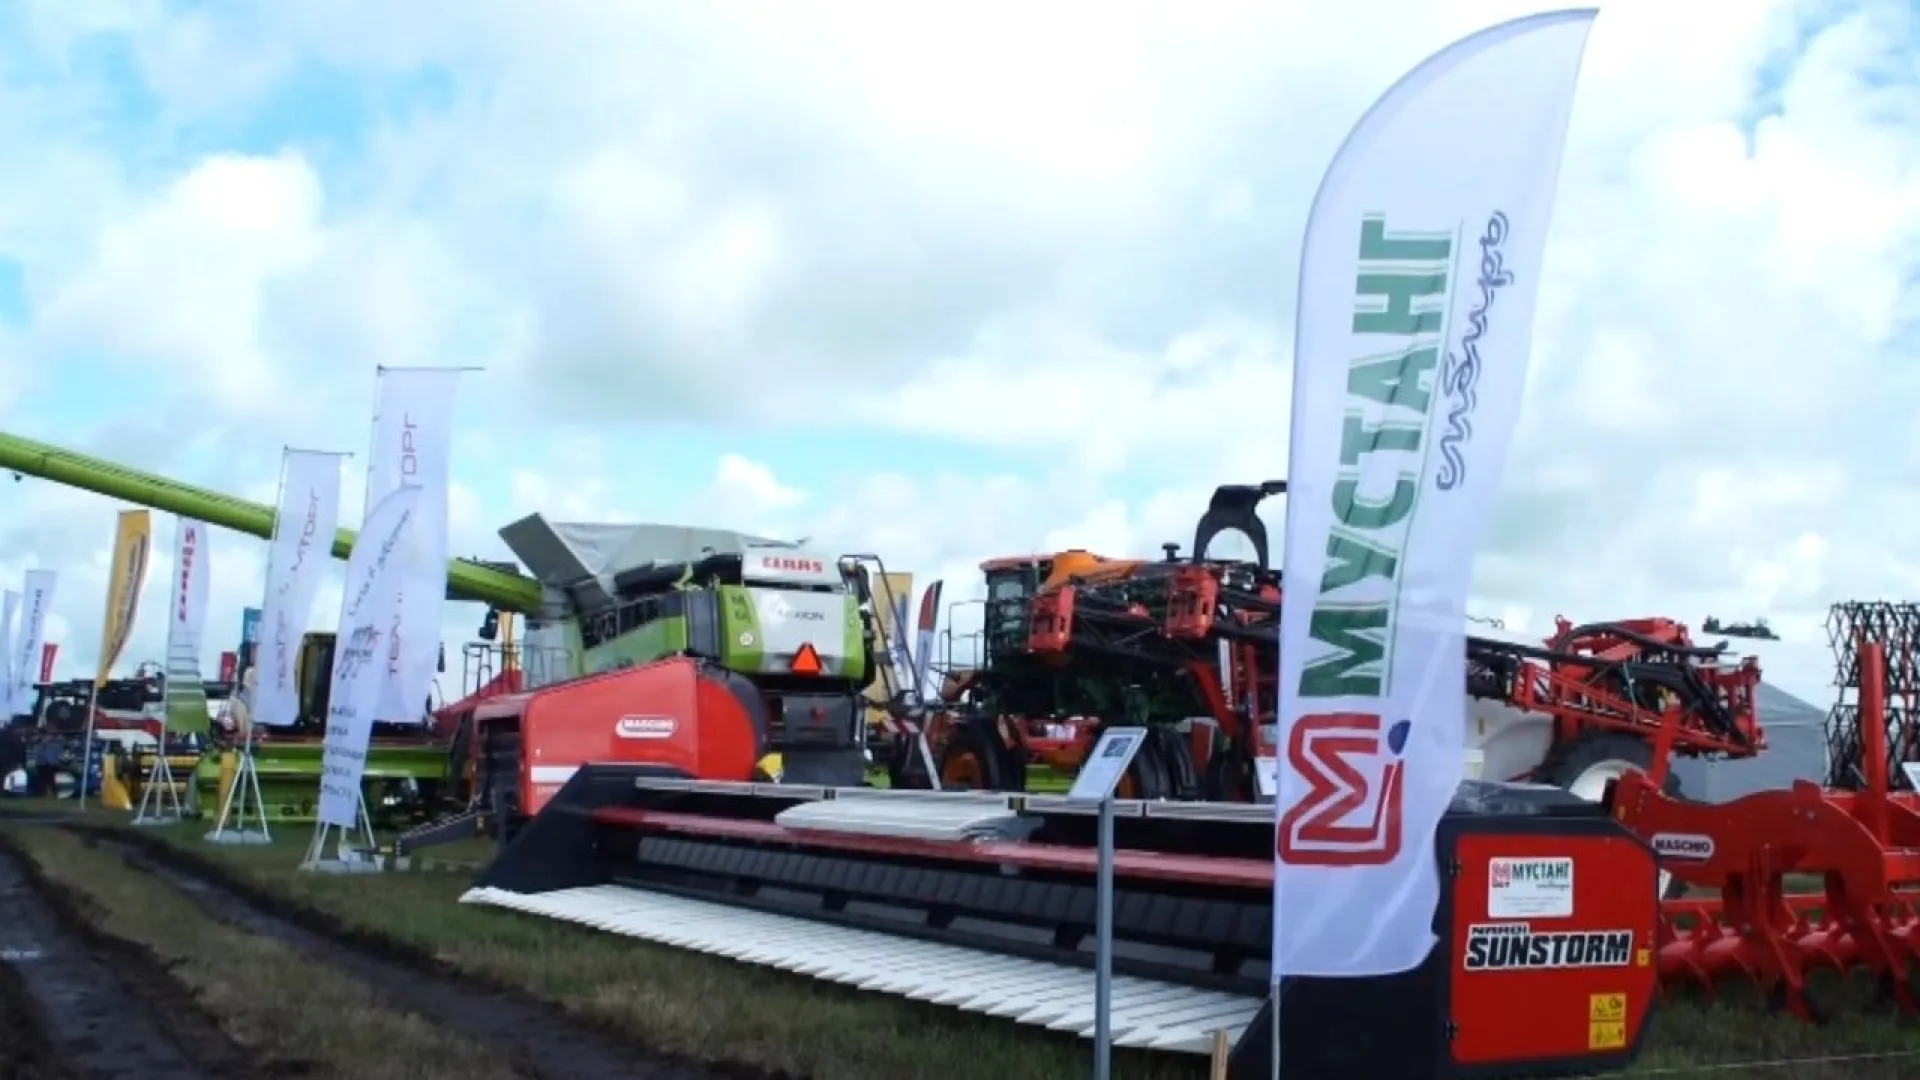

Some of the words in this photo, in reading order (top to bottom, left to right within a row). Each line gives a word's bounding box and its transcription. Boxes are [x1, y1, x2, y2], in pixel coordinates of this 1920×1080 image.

[1298, 213, 1452, 698] МУСТАНГ
[762, 556, 823, 573] CLAAS
[1655, 839, 1711, 853] MASCHIO
[1512, 862, 1569, 880] МУСТАНГ
[1466, 932, 1630, 967] SUNSTORM
